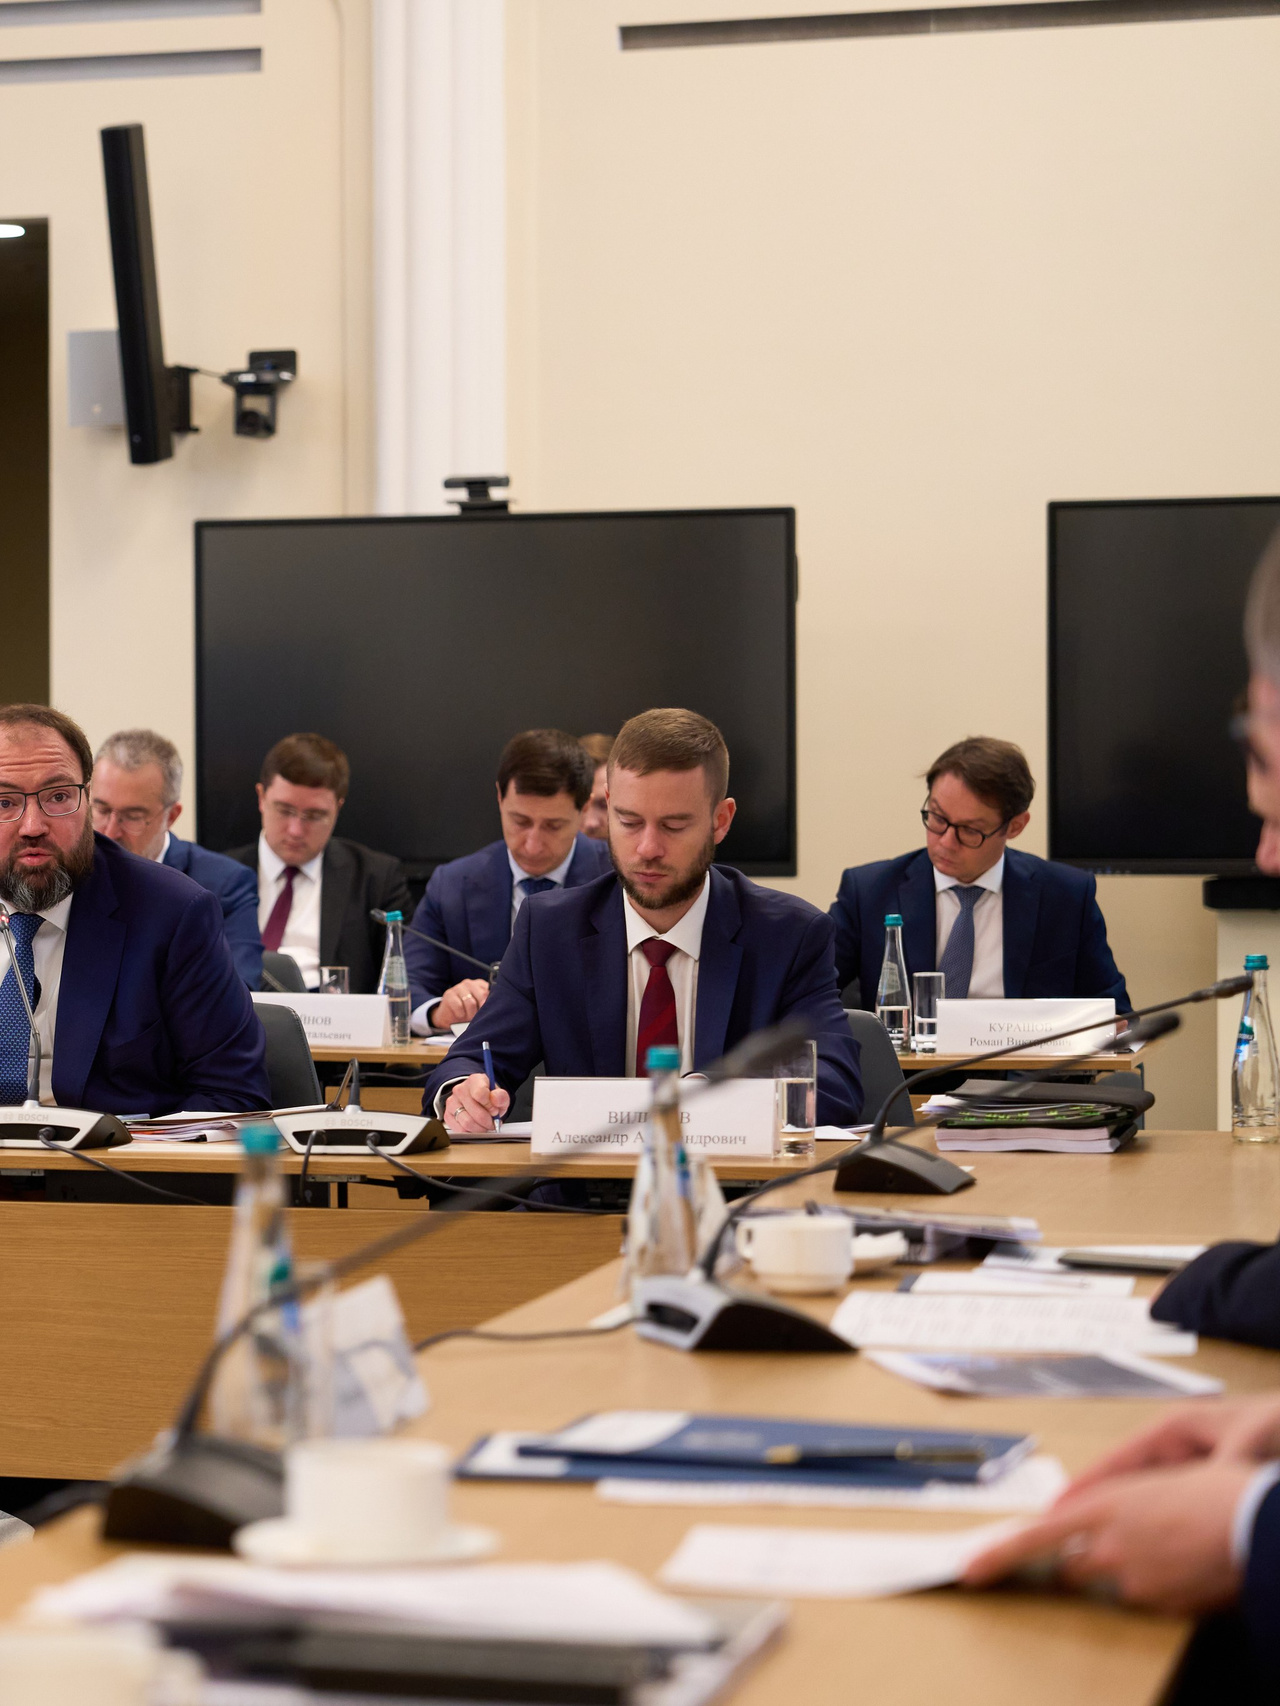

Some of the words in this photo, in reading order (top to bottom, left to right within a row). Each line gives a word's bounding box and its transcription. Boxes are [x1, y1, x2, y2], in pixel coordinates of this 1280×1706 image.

[988, 1022, 1053, 1033] КУРАШОВ
[970, 1037, 1003, 1047] Роман
[18, 1113, 49, 1122] BOSCH
[340, 1118, 373, 1128] BOSCH
[551, 1130, 629, 1146] Александр
